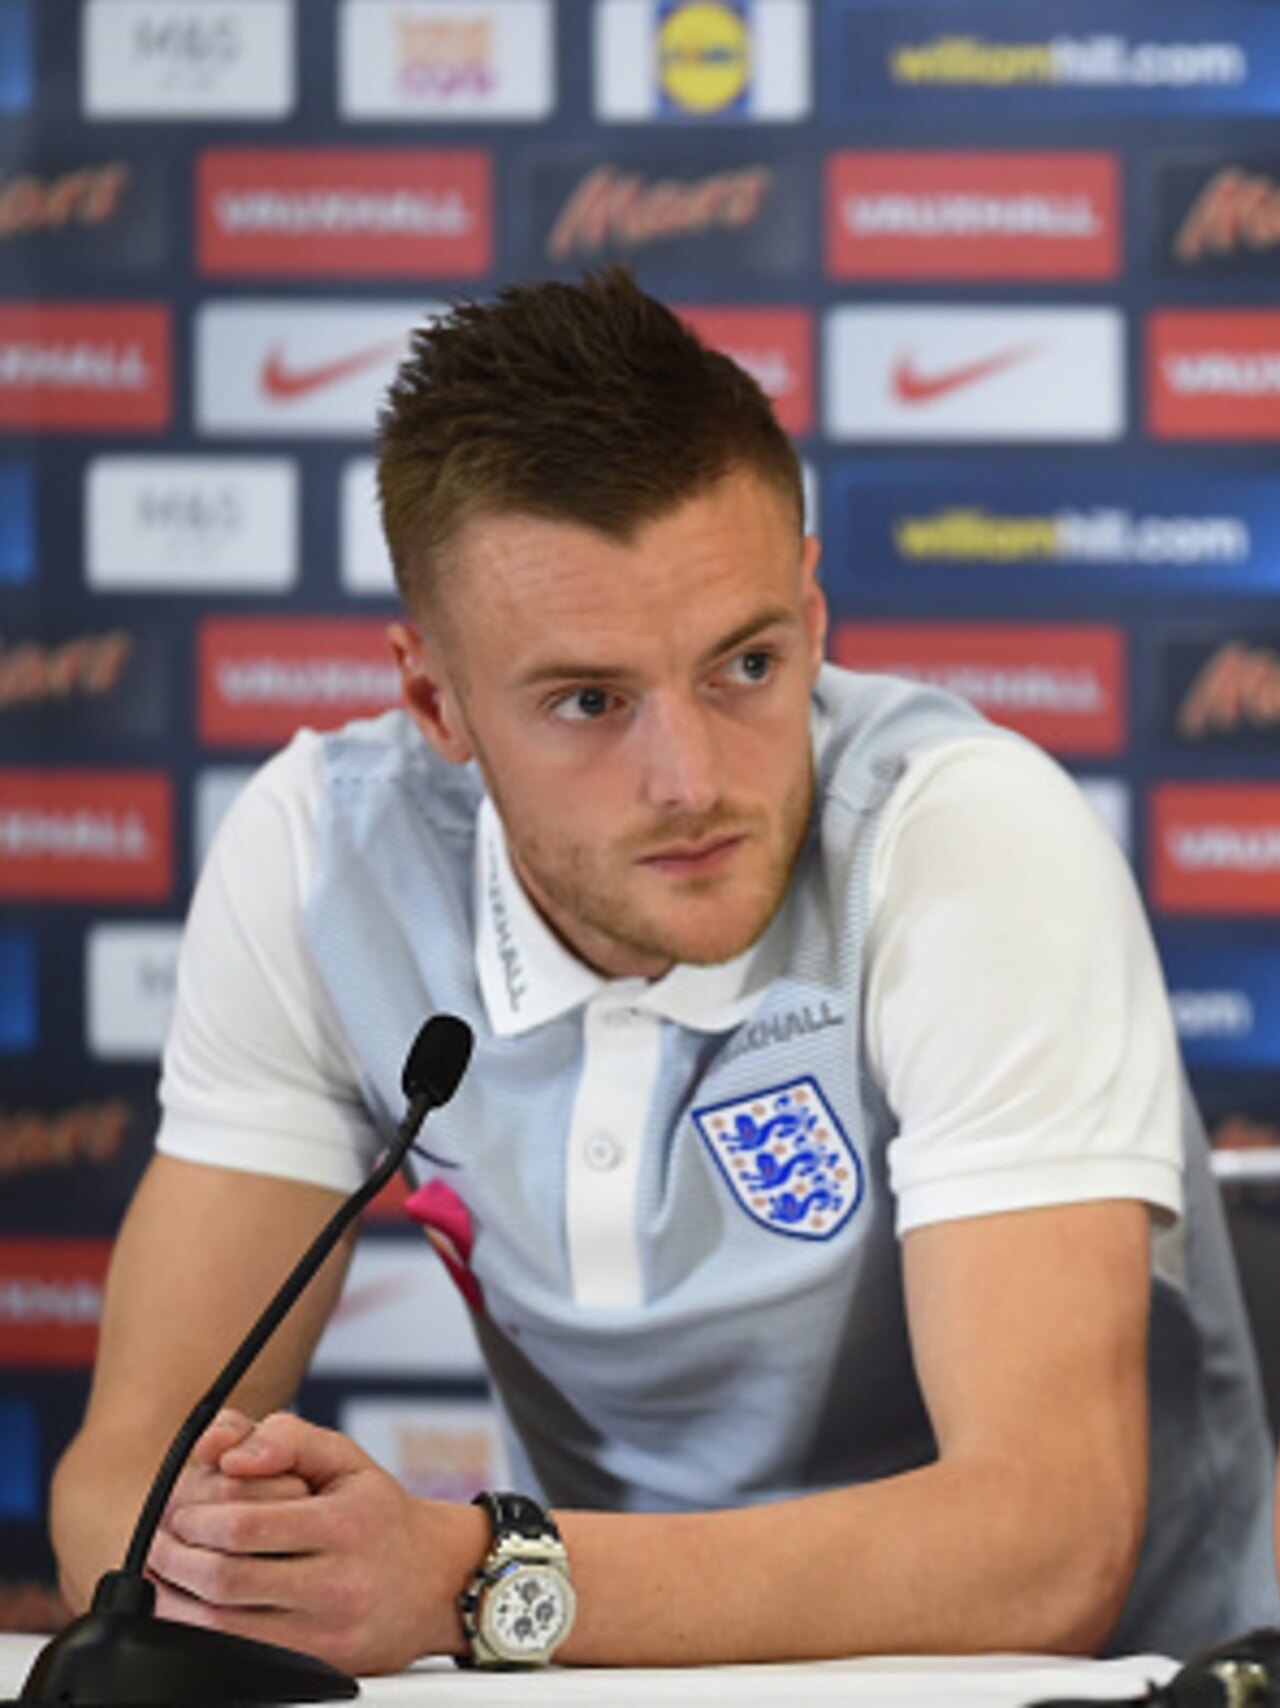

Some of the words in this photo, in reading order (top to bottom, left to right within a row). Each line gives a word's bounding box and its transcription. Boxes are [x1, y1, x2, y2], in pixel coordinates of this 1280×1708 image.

[889, 38, 1246, 86] williamhill.com
[212, 190, 472, 235] VAUXHALL
[548, 167, 775, 260] Mars
[844, 193, 1104, 237] VAUXHALL
[895, 508, 1250, 563] williamhill.com
